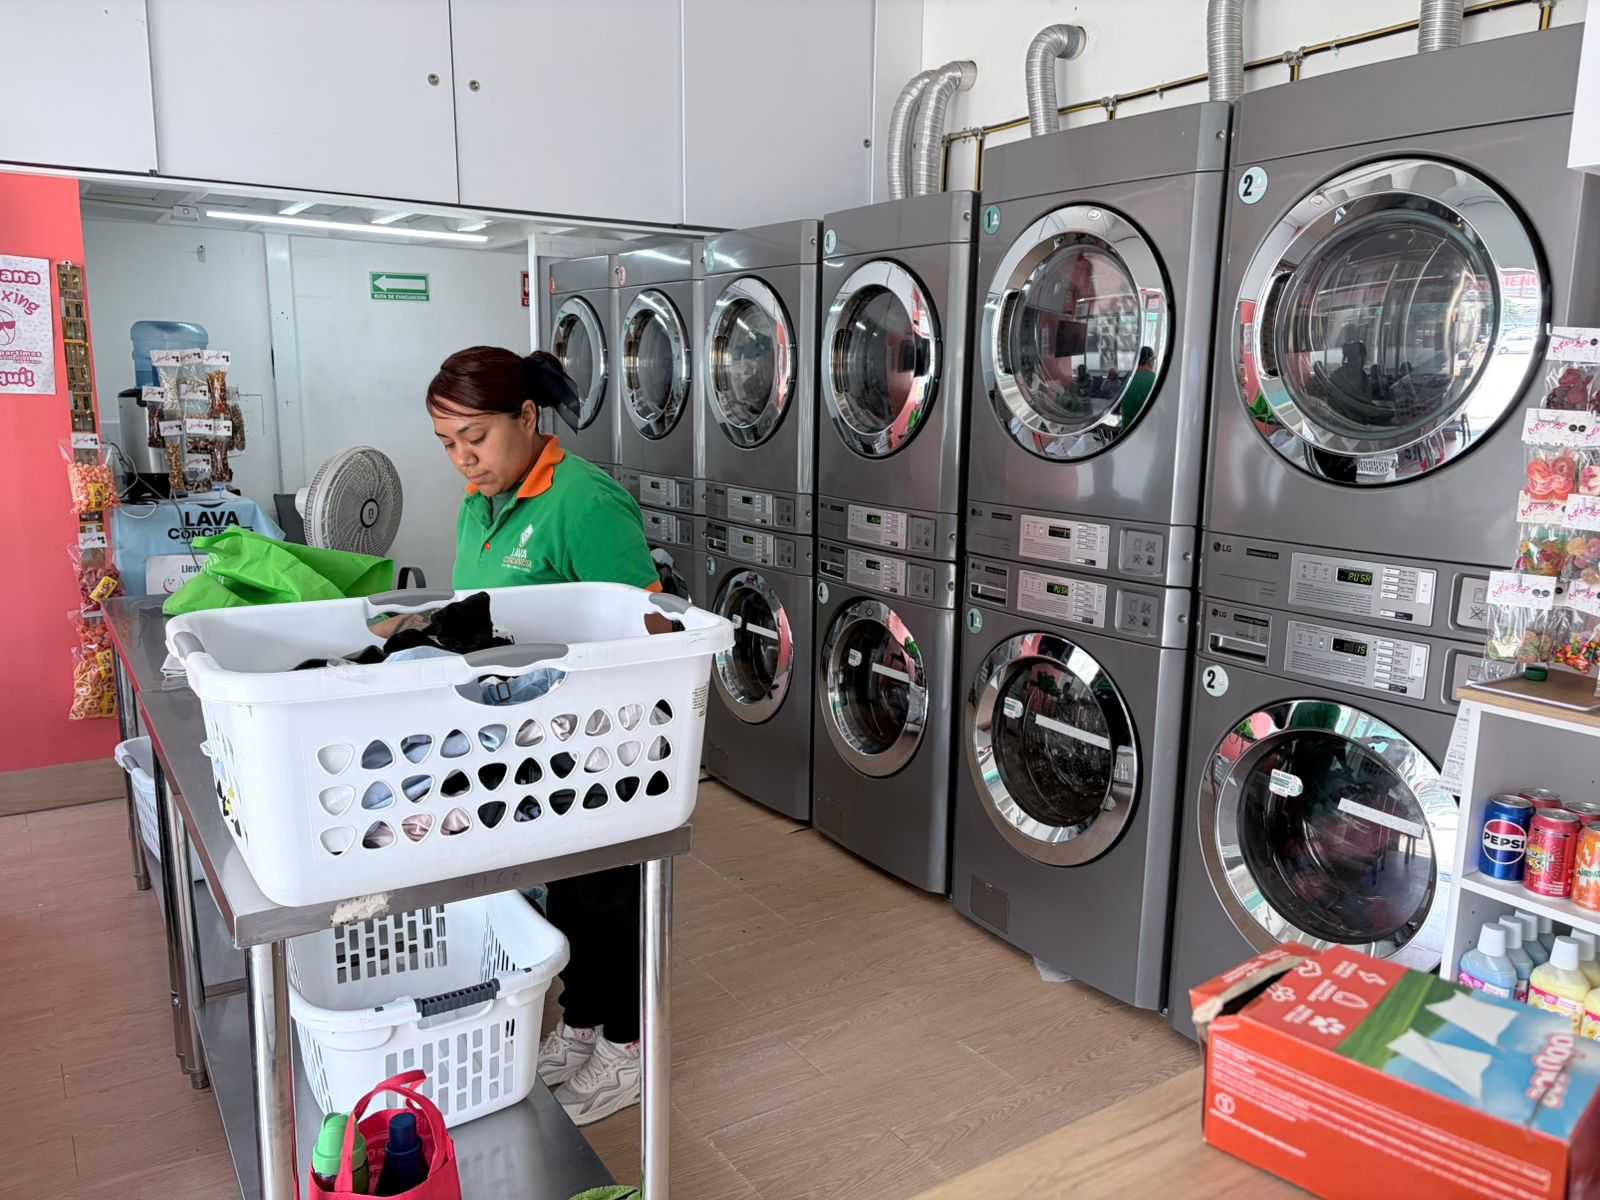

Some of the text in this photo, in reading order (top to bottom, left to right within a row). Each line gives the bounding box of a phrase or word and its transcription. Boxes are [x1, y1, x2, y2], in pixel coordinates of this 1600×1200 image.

[1243, 174, 1253, 197] 2
[987, 210, 991, 228] 1
[185, 511, 240, 527] LAVA
[1348, 572, 1373, 584] PUSH
[1053, 585, 1069, 596] PUSH
[970, 612, 974, 628] 1
[1206, 669, 1216, 689] 2
[1484, 832, 1526, 850] PEPSI
